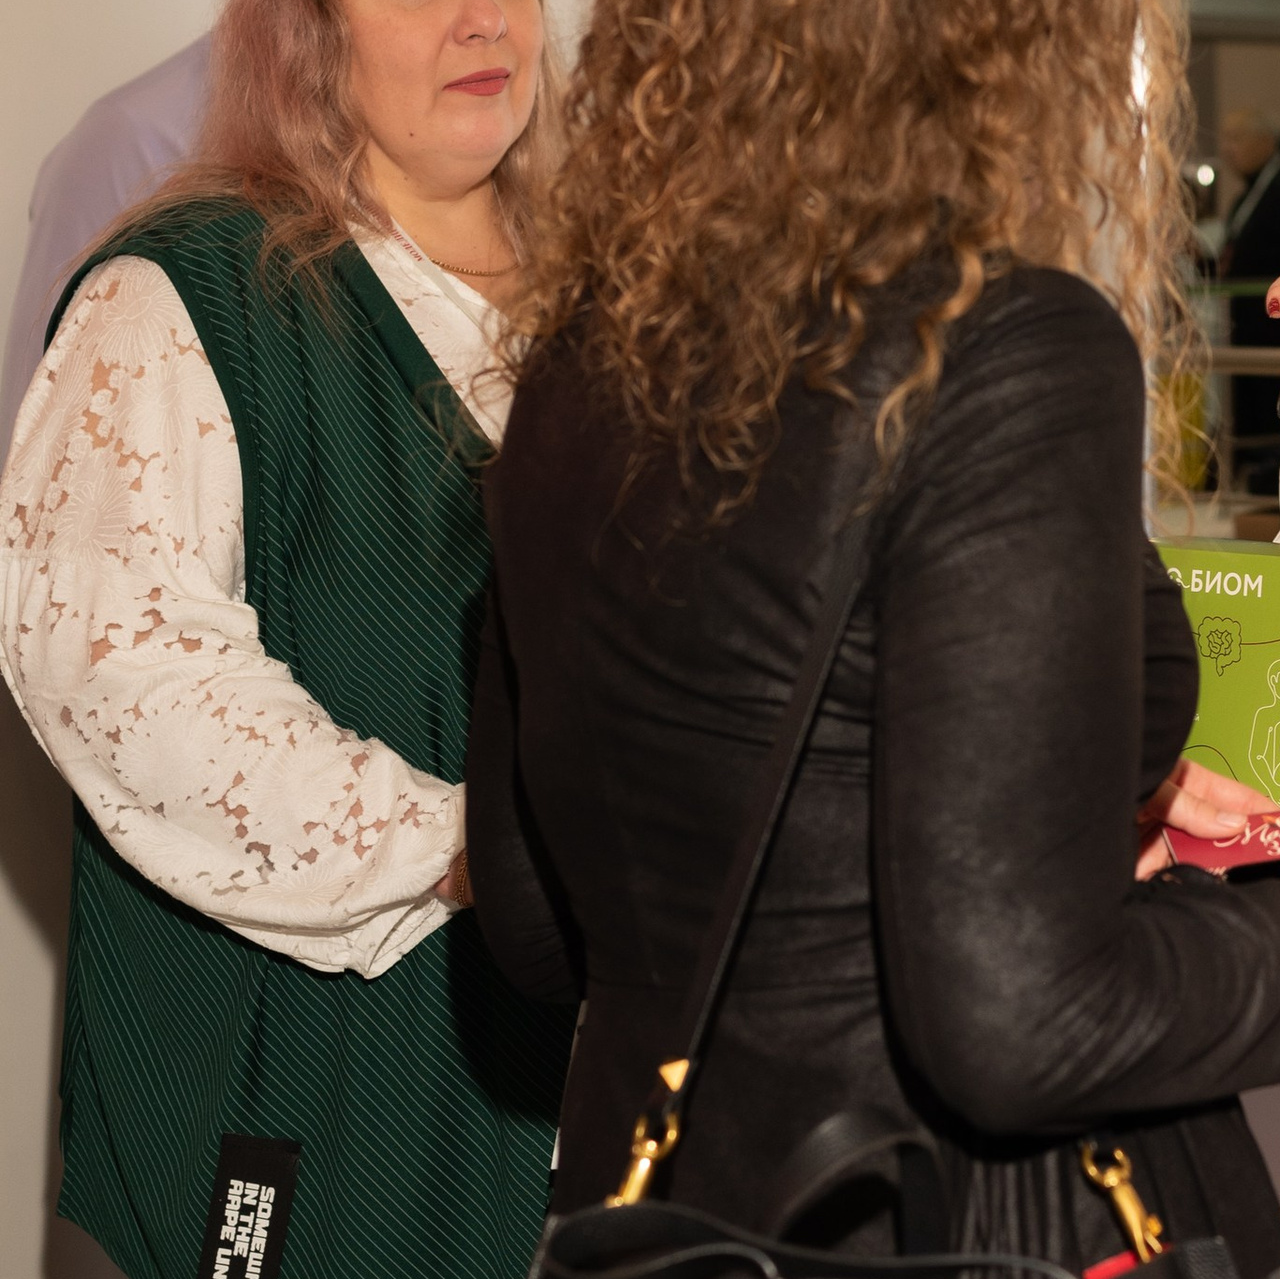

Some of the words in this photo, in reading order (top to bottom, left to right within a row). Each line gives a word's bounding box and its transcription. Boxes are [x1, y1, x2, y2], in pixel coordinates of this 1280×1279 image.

[1190, 569, 1263, 598] БИОМ
[220, 1179, 244, 1242] AAPE
[242, 1182, 260, 1206] IN
[233, 1211, 255, 1258] THE
